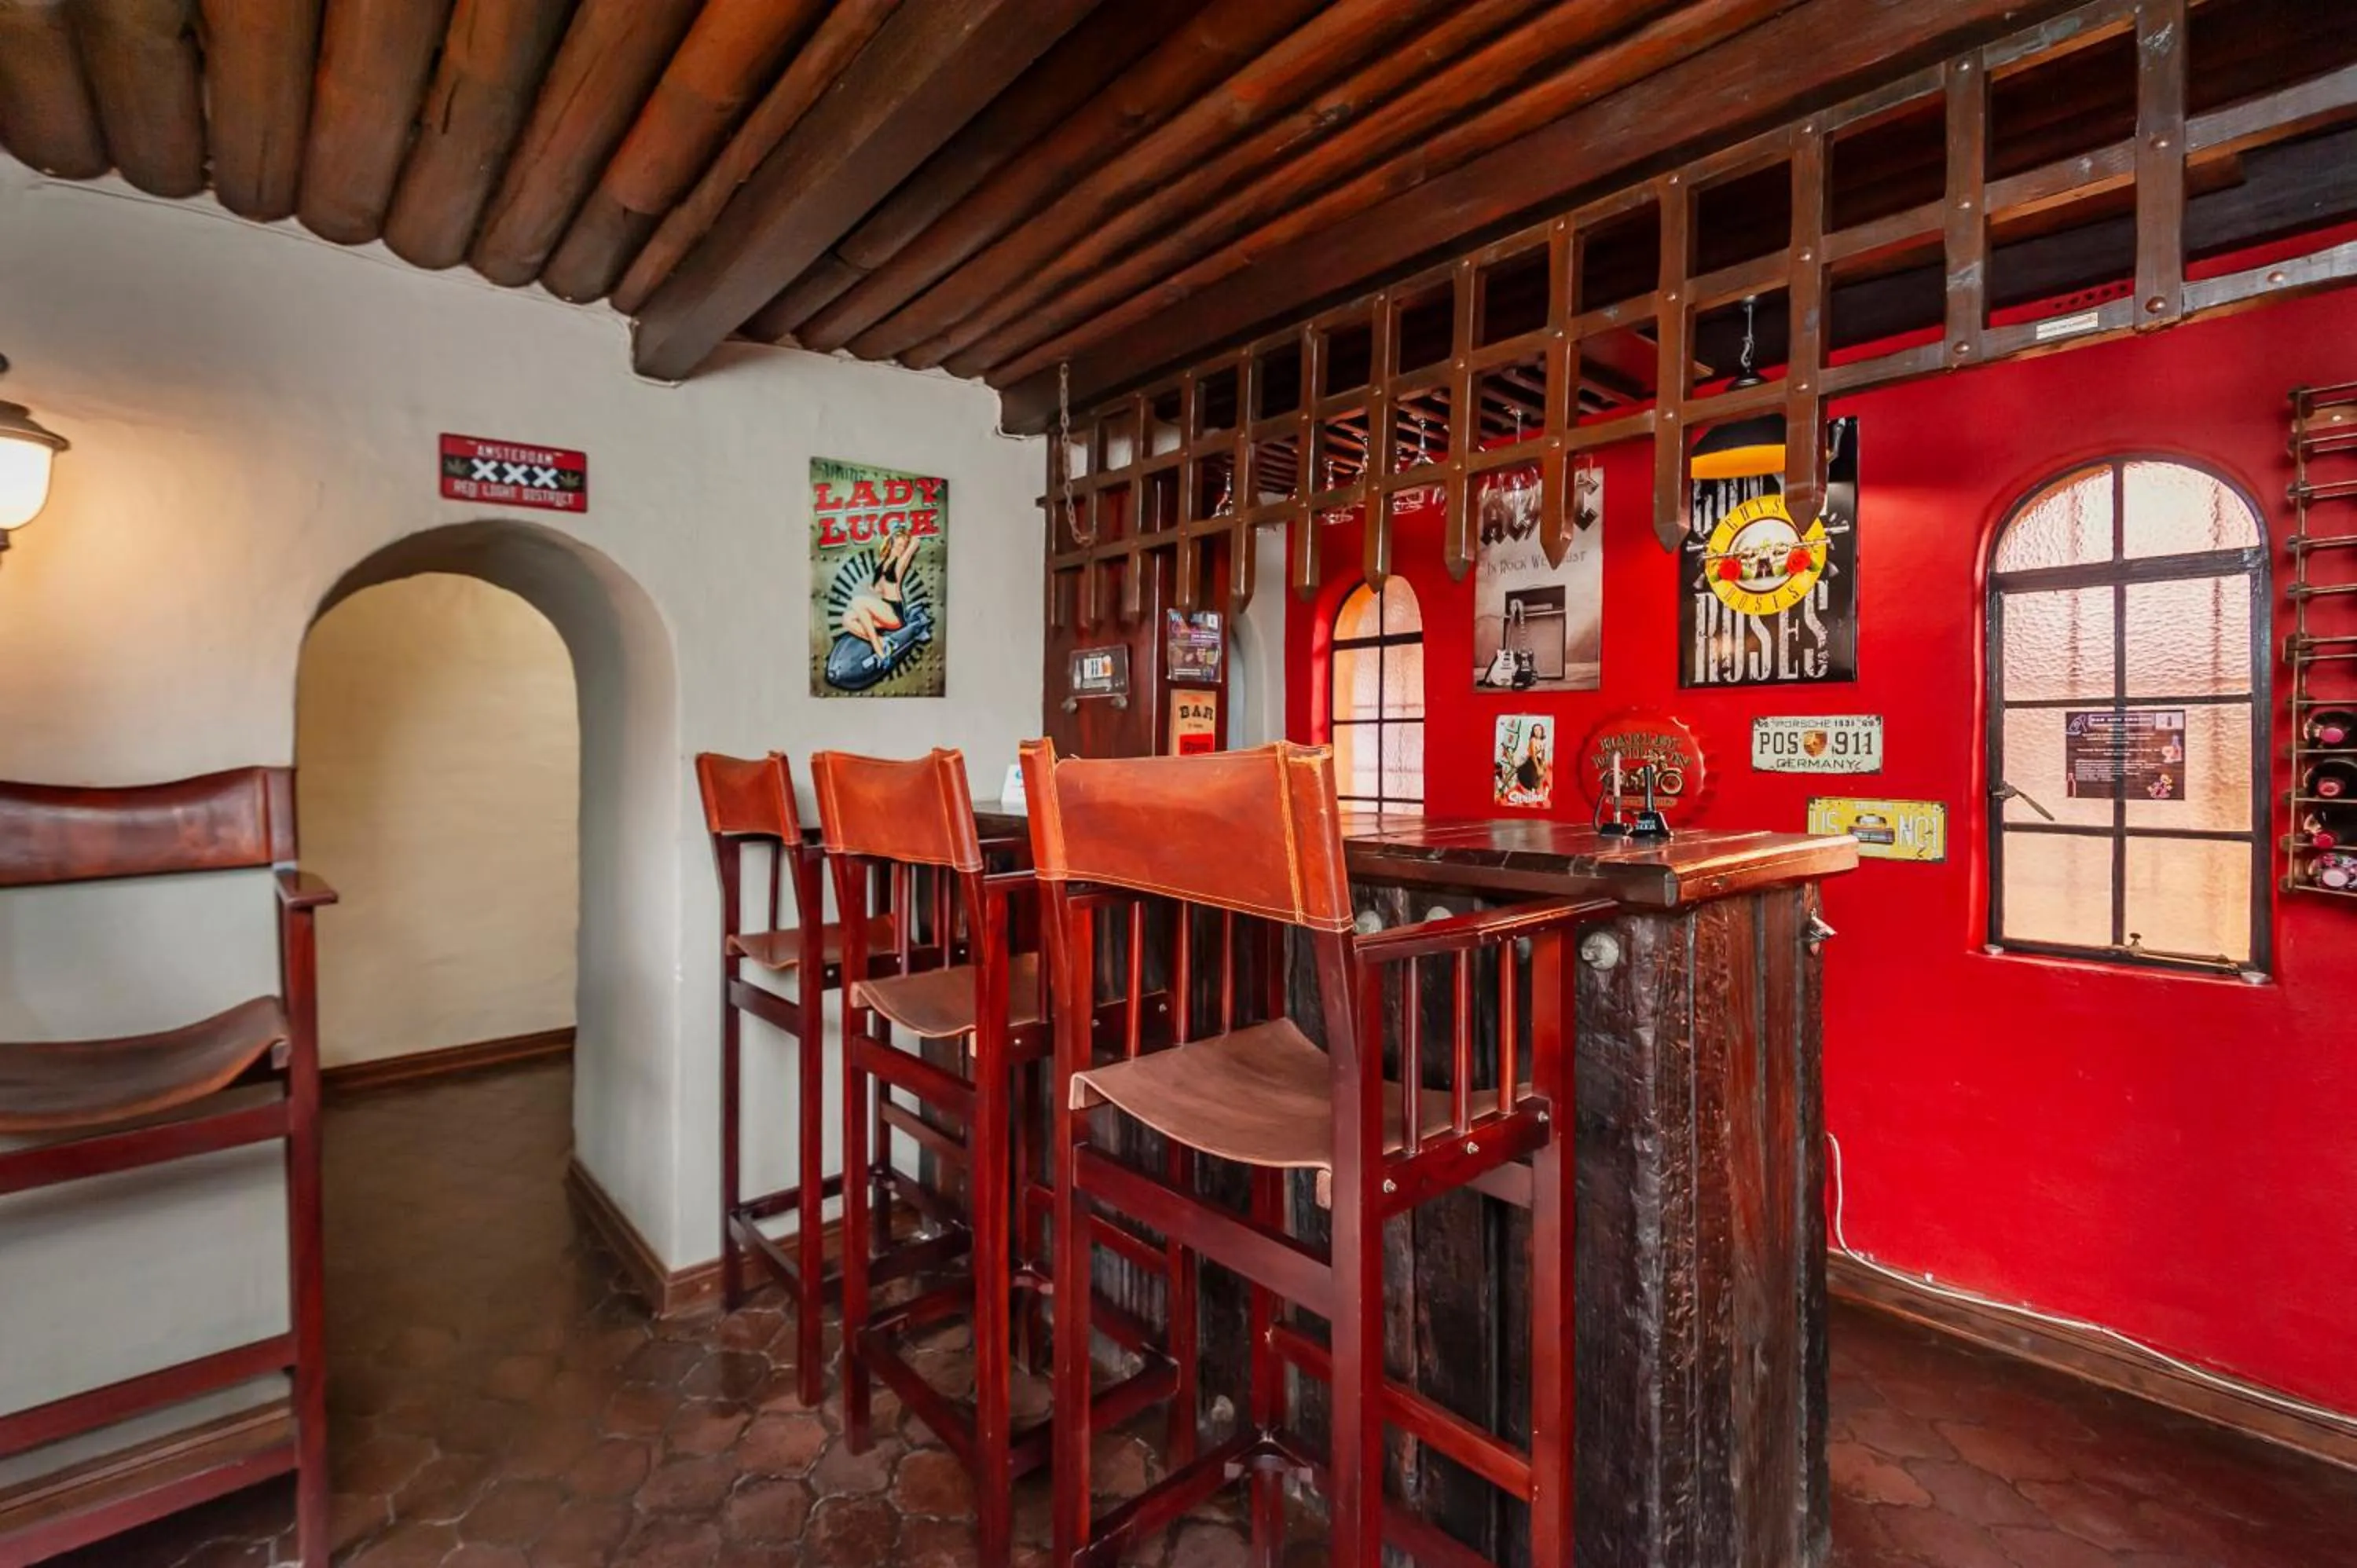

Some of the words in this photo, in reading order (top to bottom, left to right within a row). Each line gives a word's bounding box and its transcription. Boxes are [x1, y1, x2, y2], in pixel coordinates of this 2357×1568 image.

[477, 445, 553, 465] AMSTERDAM
[471, 457, 559, 489] XXX
[453, 479, 478, 498] RED
[482, 484, 516, 500] LIGHT
[522, 488, 574, 507] DISTRICT
[814, 478, 943, 515] LADY
[819, 508, 940, 548] LUCK
[1499, 558, 1527, 575] ROCK
[1694, 578, 1830, 683] ROSES
[1179, 704, 1214, 721] BAR
[1758, 731, 1799, 755] POS
[1834, 731, 1874, 755] 911
[1776, 758, 1857, 770] GERMANY
